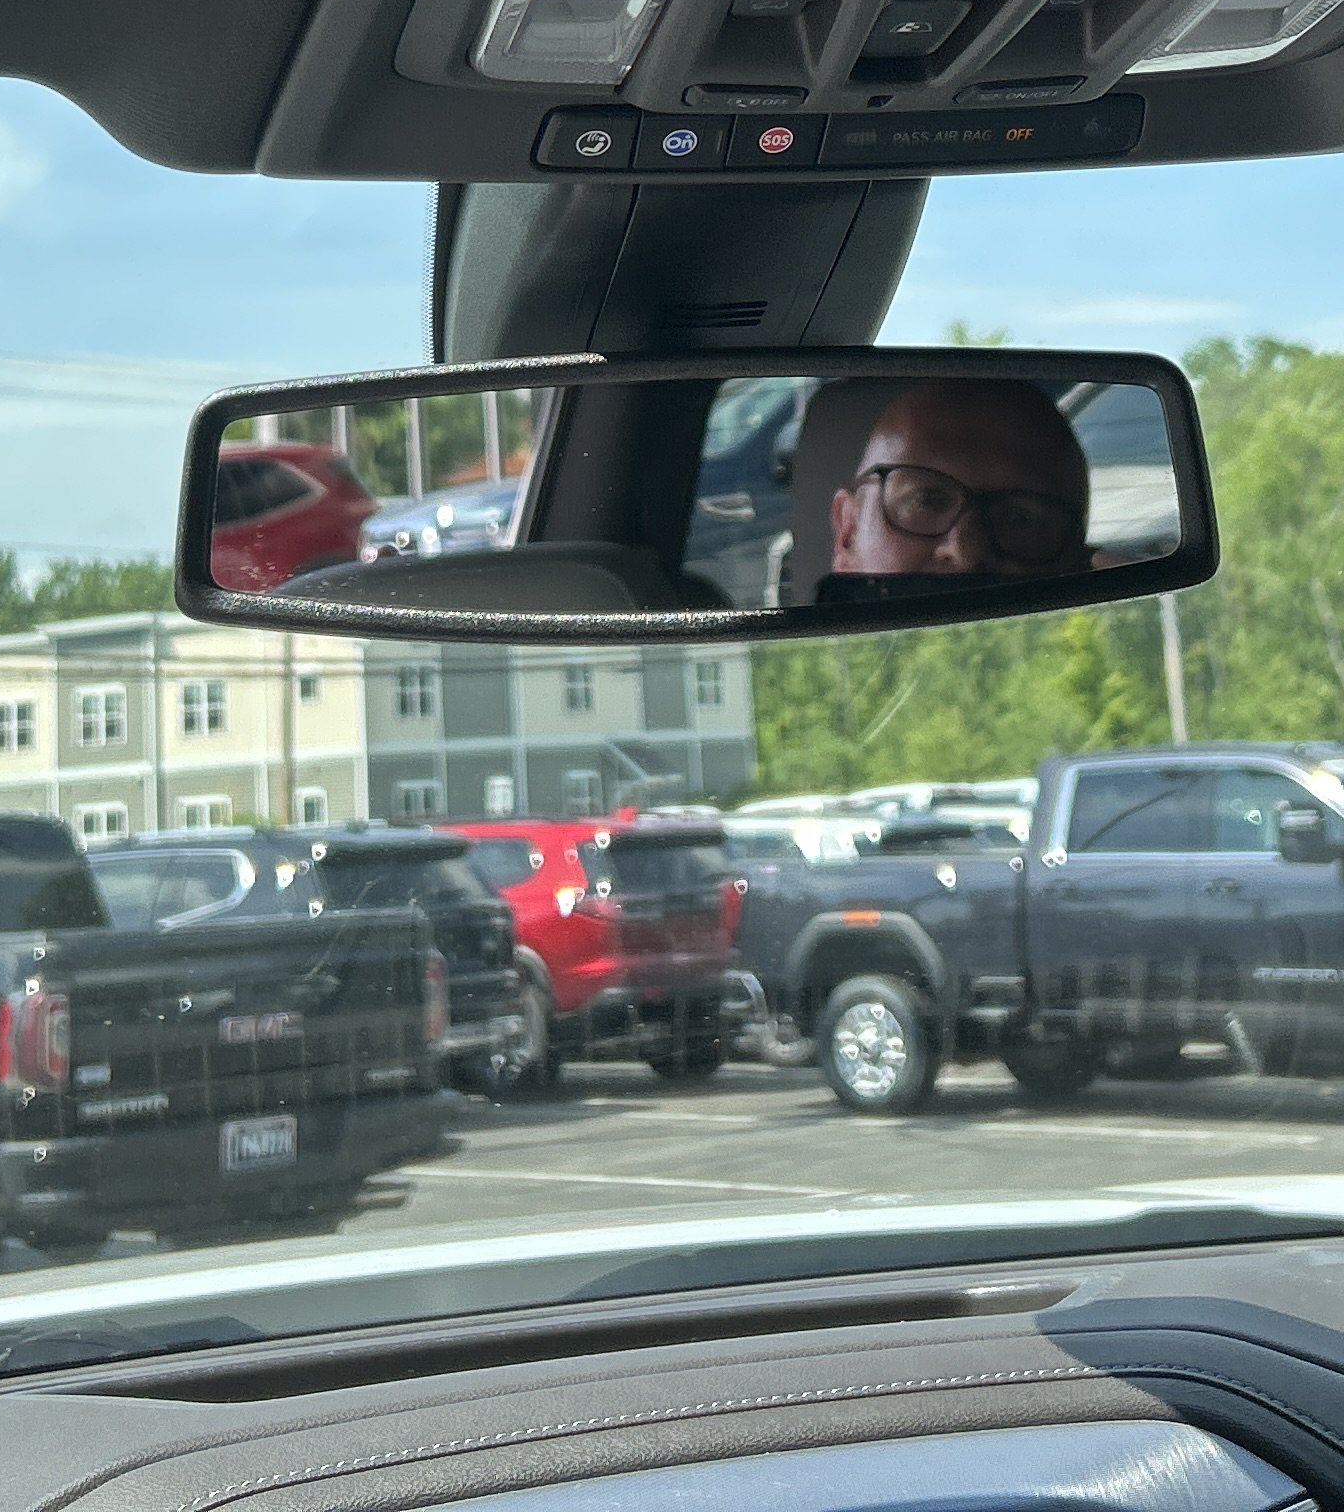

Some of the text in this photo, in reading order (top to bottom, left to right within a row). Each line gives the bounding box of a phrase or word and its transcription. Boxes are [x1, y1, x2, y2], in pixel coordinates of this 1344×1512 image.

[762, 133, 790, 147] SOS
[892, 128, 1035, 144] PASS AIR BAG OFF
